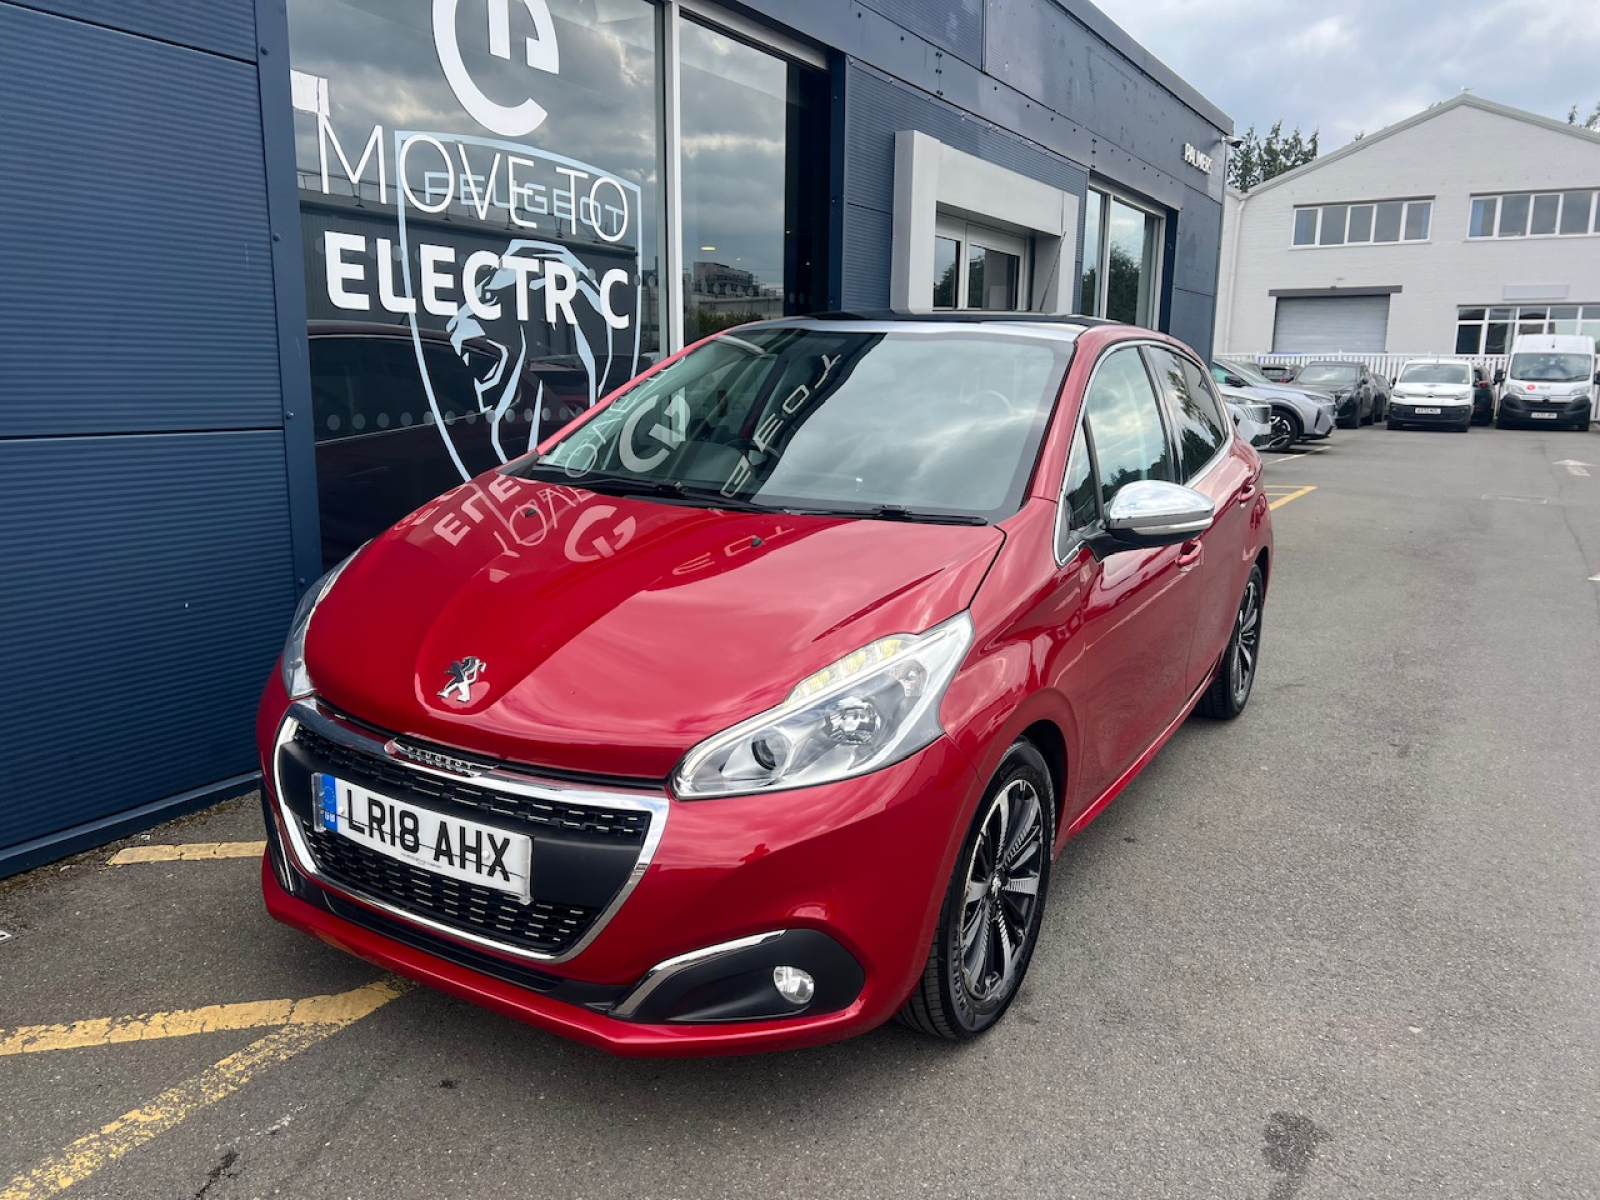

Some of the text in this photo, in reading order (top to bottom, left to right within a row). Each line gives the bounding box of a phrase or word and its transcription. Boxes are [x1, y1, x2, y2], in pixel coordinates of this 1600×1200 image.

[317, 114, 628, 242] MOVE TO
[324, 230, 630, 329] ELECTRC
[347, 789, 511, 882] LR18 AHX
